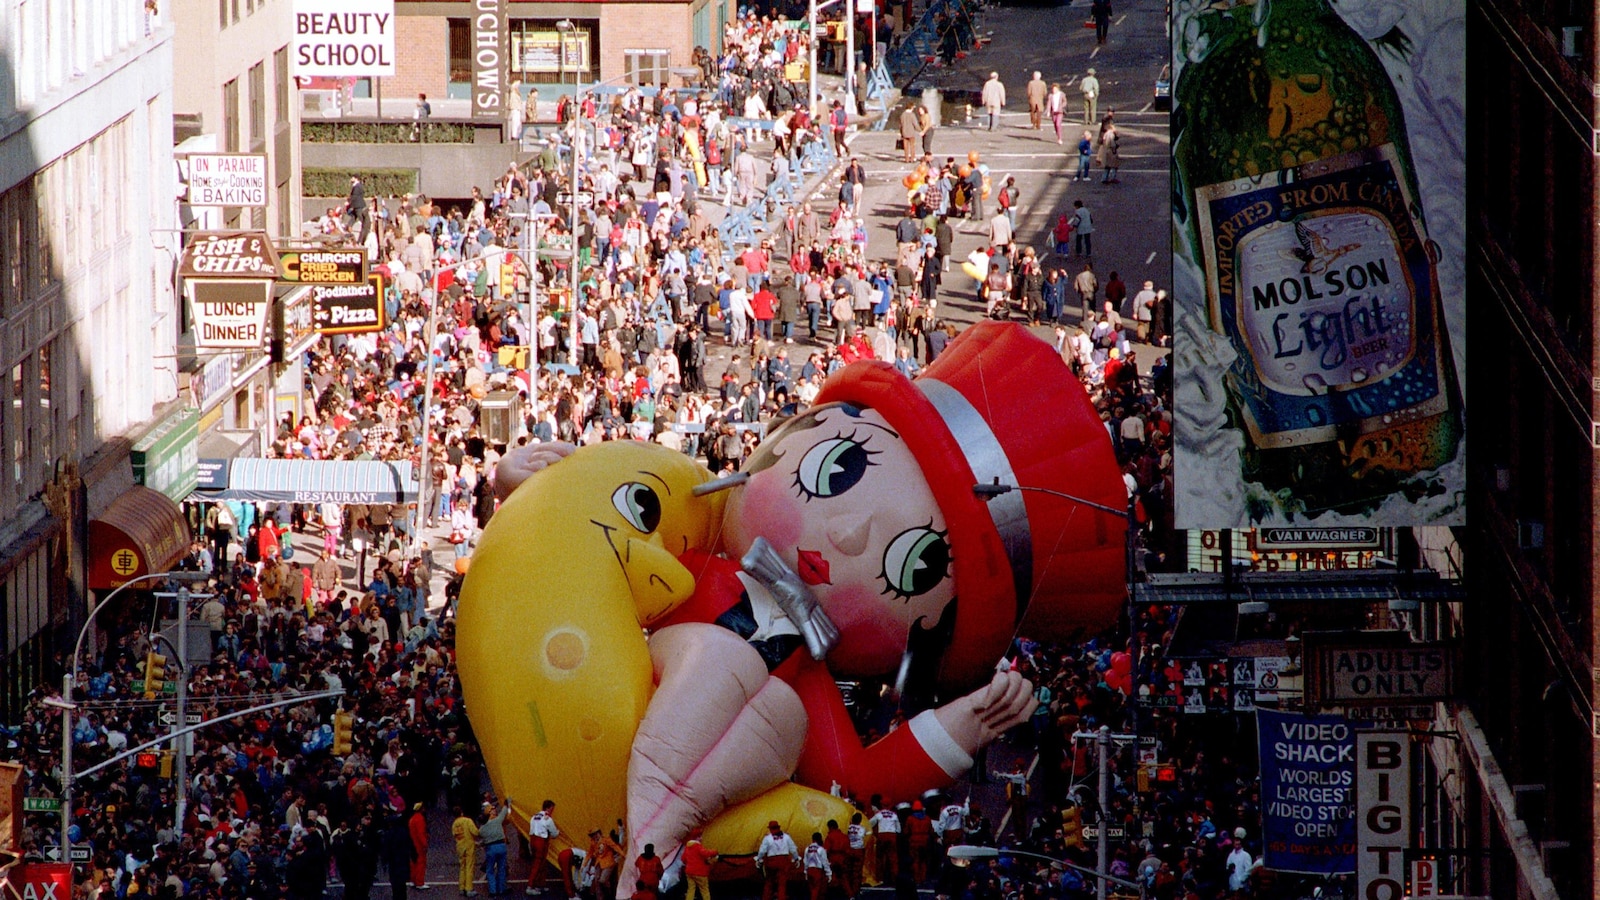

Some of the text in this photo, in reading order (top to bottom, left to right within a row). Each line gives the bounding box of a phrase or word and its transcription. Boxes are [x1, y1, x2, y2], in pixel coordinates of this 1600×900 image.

[296, 13, 390, 34] BEAUTY
[298, 44, 391, 66] SCHOOL
[196, 158, 258, 173] ON PARADE
[204, 189, 262, 203] BAKING
[1215, 181, 1418, 296] IMPORTED FROM CANADA
[251, 241, 260, 254] &
[300, 253, 361, 264] CHURCH'S
[300, 263, 338, 272] FRIED
[300, 272, 355, 282] CHICKEN
[1252, 258, 1391, 311] MOLSON
[317, 285, 375, 298] Godfather's
[204, 303, 255, 317] LUNCH
[330, 306, 377, 324] Pizza
[204, 324, 257, 340] DINNER
[1274, 295, 1392, 370] Light
[1352, 338, 1390, 360] BEER
[295, 491, 377, 502] RESTAURANT
[1275, 531, 1366, 541] VAN WAGNER
[115, 550, 135, 575] 車
[1336, 652, 1442, 672] ADULTS
[1352, 674, 1430, 694] ONLY
[1280, 722, 1349, 741] VIDEO
[1274, 743, 1354, 764] SHACK
[1278, 768, 1352, 786] WORLDS
[1276, 785, 1354, 804] LARGEST
[1366, 742, 1402, 834] BIG
[30, 800, 38, 809] W
[40, 800, 52, 808] 49
[1267, 802, 1314, 819] VIDEO
[1294, 822, 1338, 838] OPEN
[1290, 842, 1320, 856] DAYS
[1323, 846, 1332, 856] A
